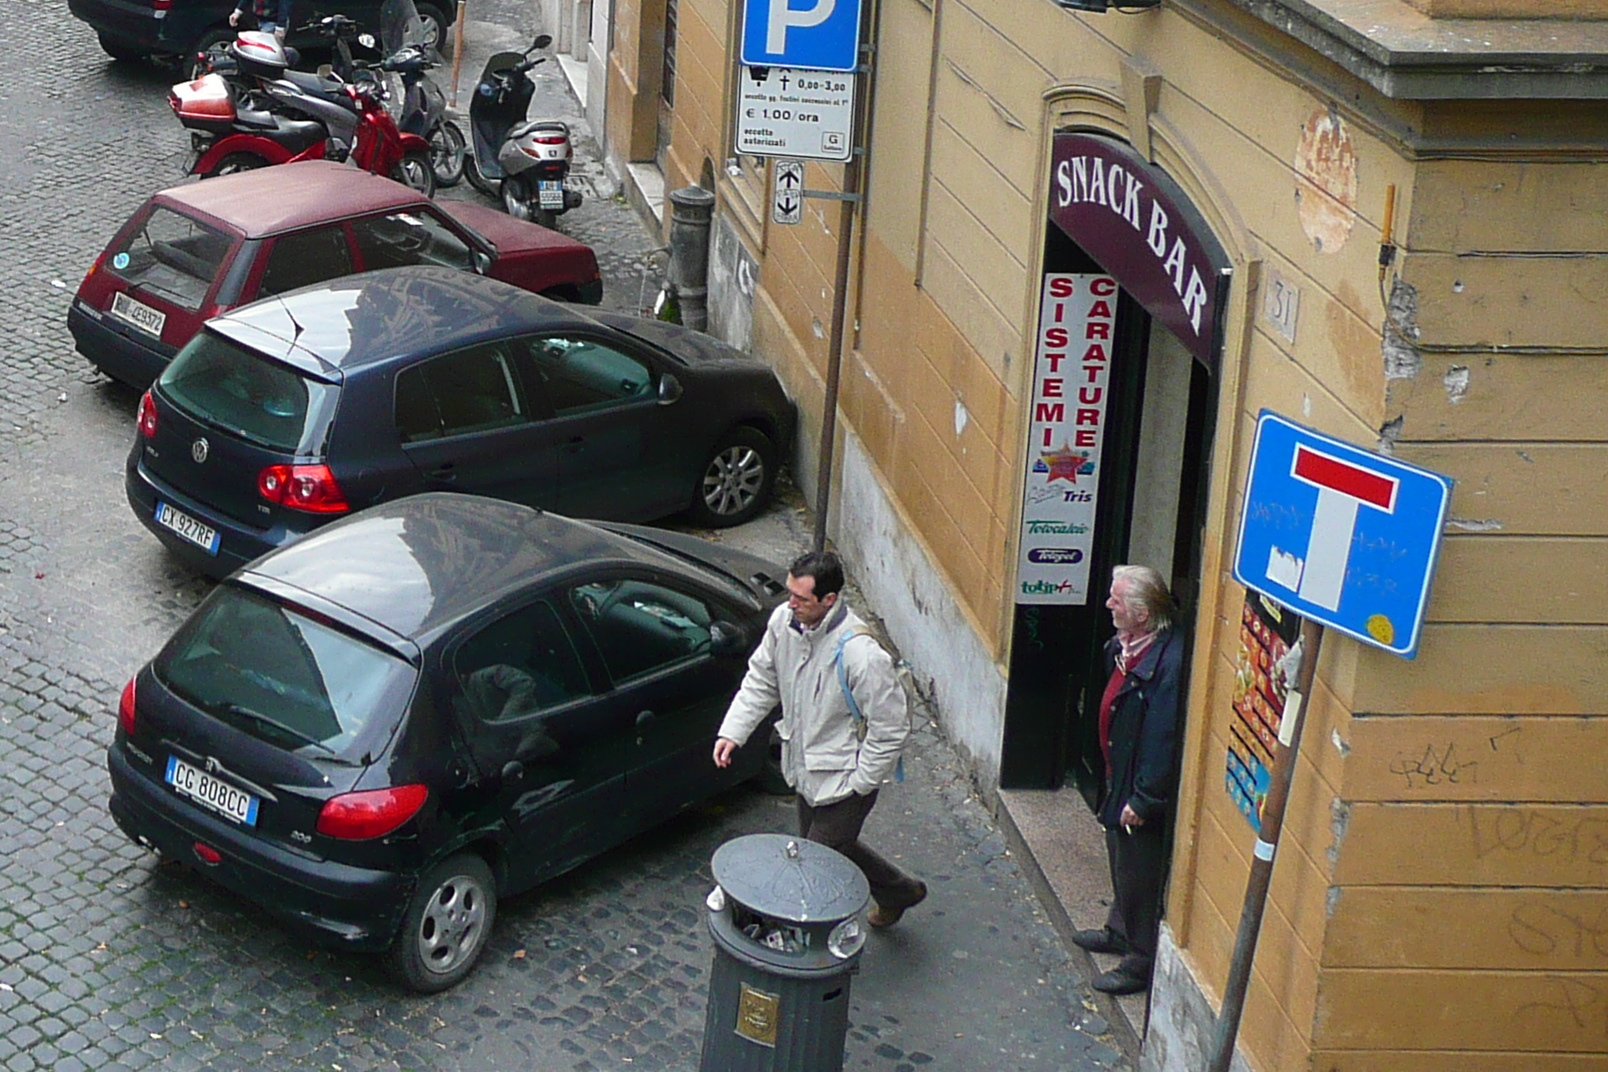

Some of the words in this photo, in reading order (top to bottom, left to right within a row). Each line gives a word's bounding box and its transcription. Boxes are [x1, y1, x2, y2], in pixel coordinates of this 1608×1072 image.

[746, 108, 755, 119] €
[828, 135, 838, 145] G
[1057, 155, 1144, 231] SNACK
[1146, 199, 1208, 337] BAR
[1271, 280, 1292, 326] 31
[1035, 277, 1073, 447] SISTEMI
[1075, 277, 1116, 447] CARATURE
[1063, 490, 1093, 503] Tris
[161, 504, 176, 527] CX
[178, 514, 214, 547] 927RF
[175, 764, 195, 789] CG
[198, 776, 248, 816] 808CC
